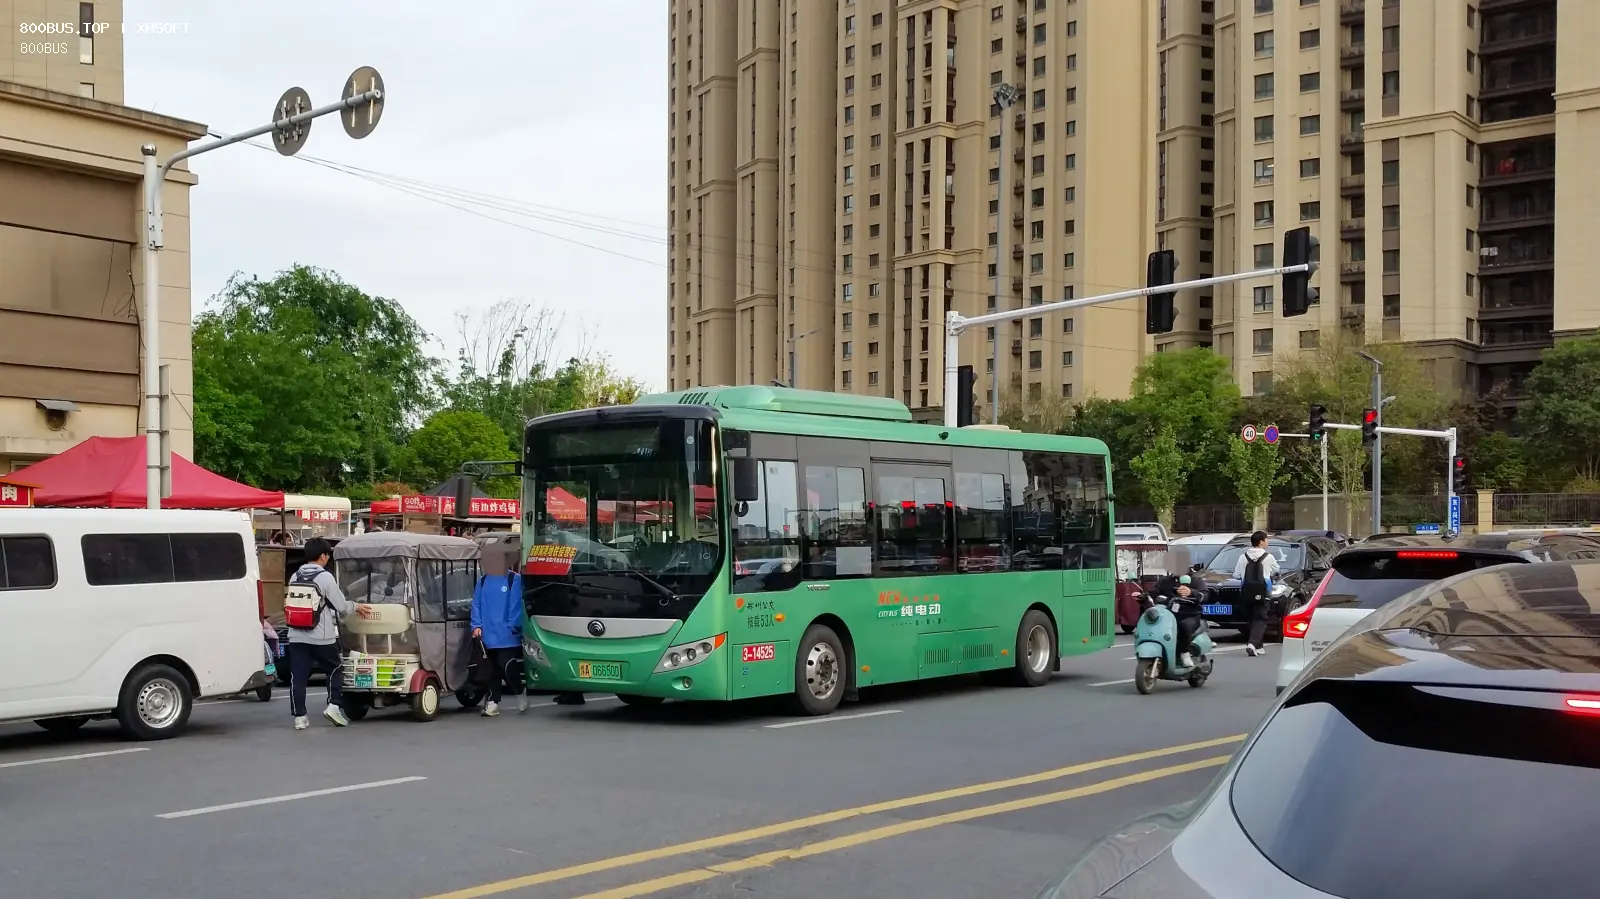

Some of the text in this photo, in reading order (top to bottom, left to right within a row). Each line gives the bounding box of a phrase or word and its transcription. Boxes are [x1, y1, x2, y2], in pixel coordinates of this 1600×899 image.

[1244, 428, 1254, 439] 40
[900, 603, 941, 617] 纯电动
[743, 645, 774, 661] 3-14525
